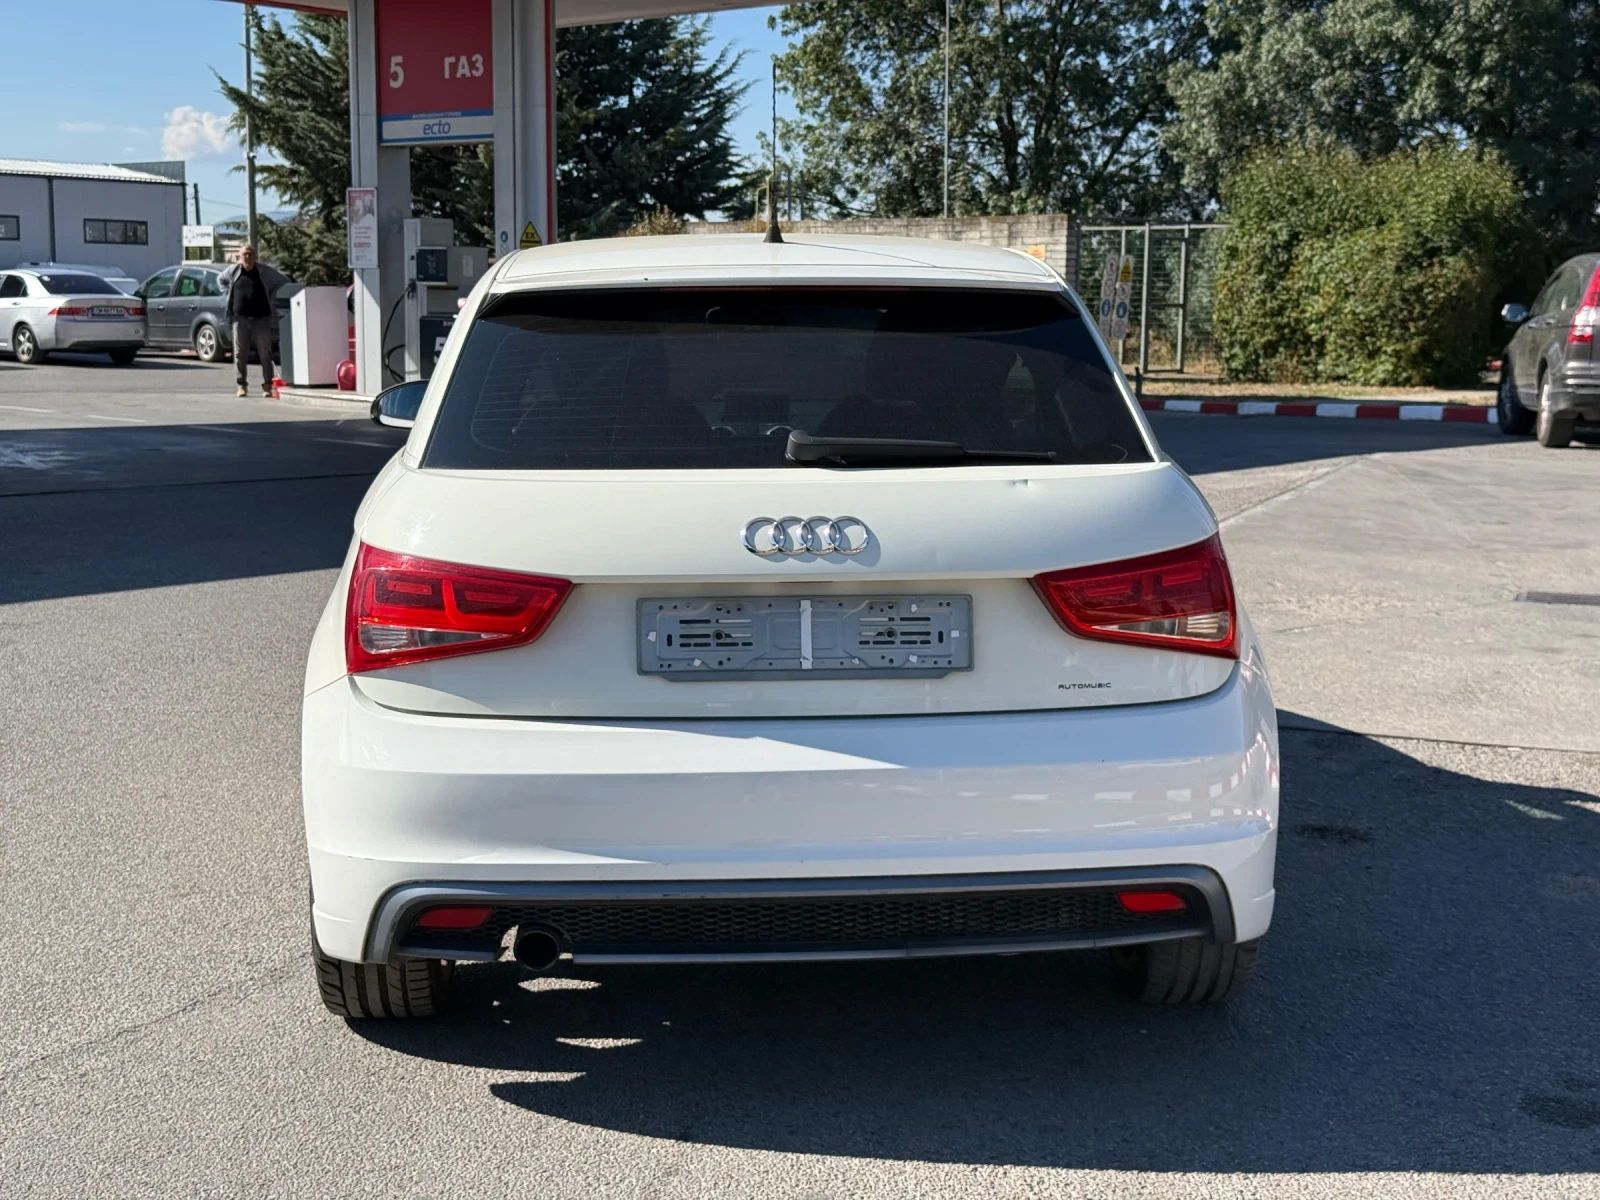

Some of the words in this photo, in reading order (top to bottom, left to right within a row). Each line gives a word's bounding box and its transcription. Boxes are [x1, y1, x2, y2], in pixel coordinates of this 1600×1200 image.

[389, 55, 405, 88] 5
[444, 53, 485, 79] ГАЗ
[423, 119, 451, 136] ecto
[1057, 682, 1112, 690] AUTOMUSIC
